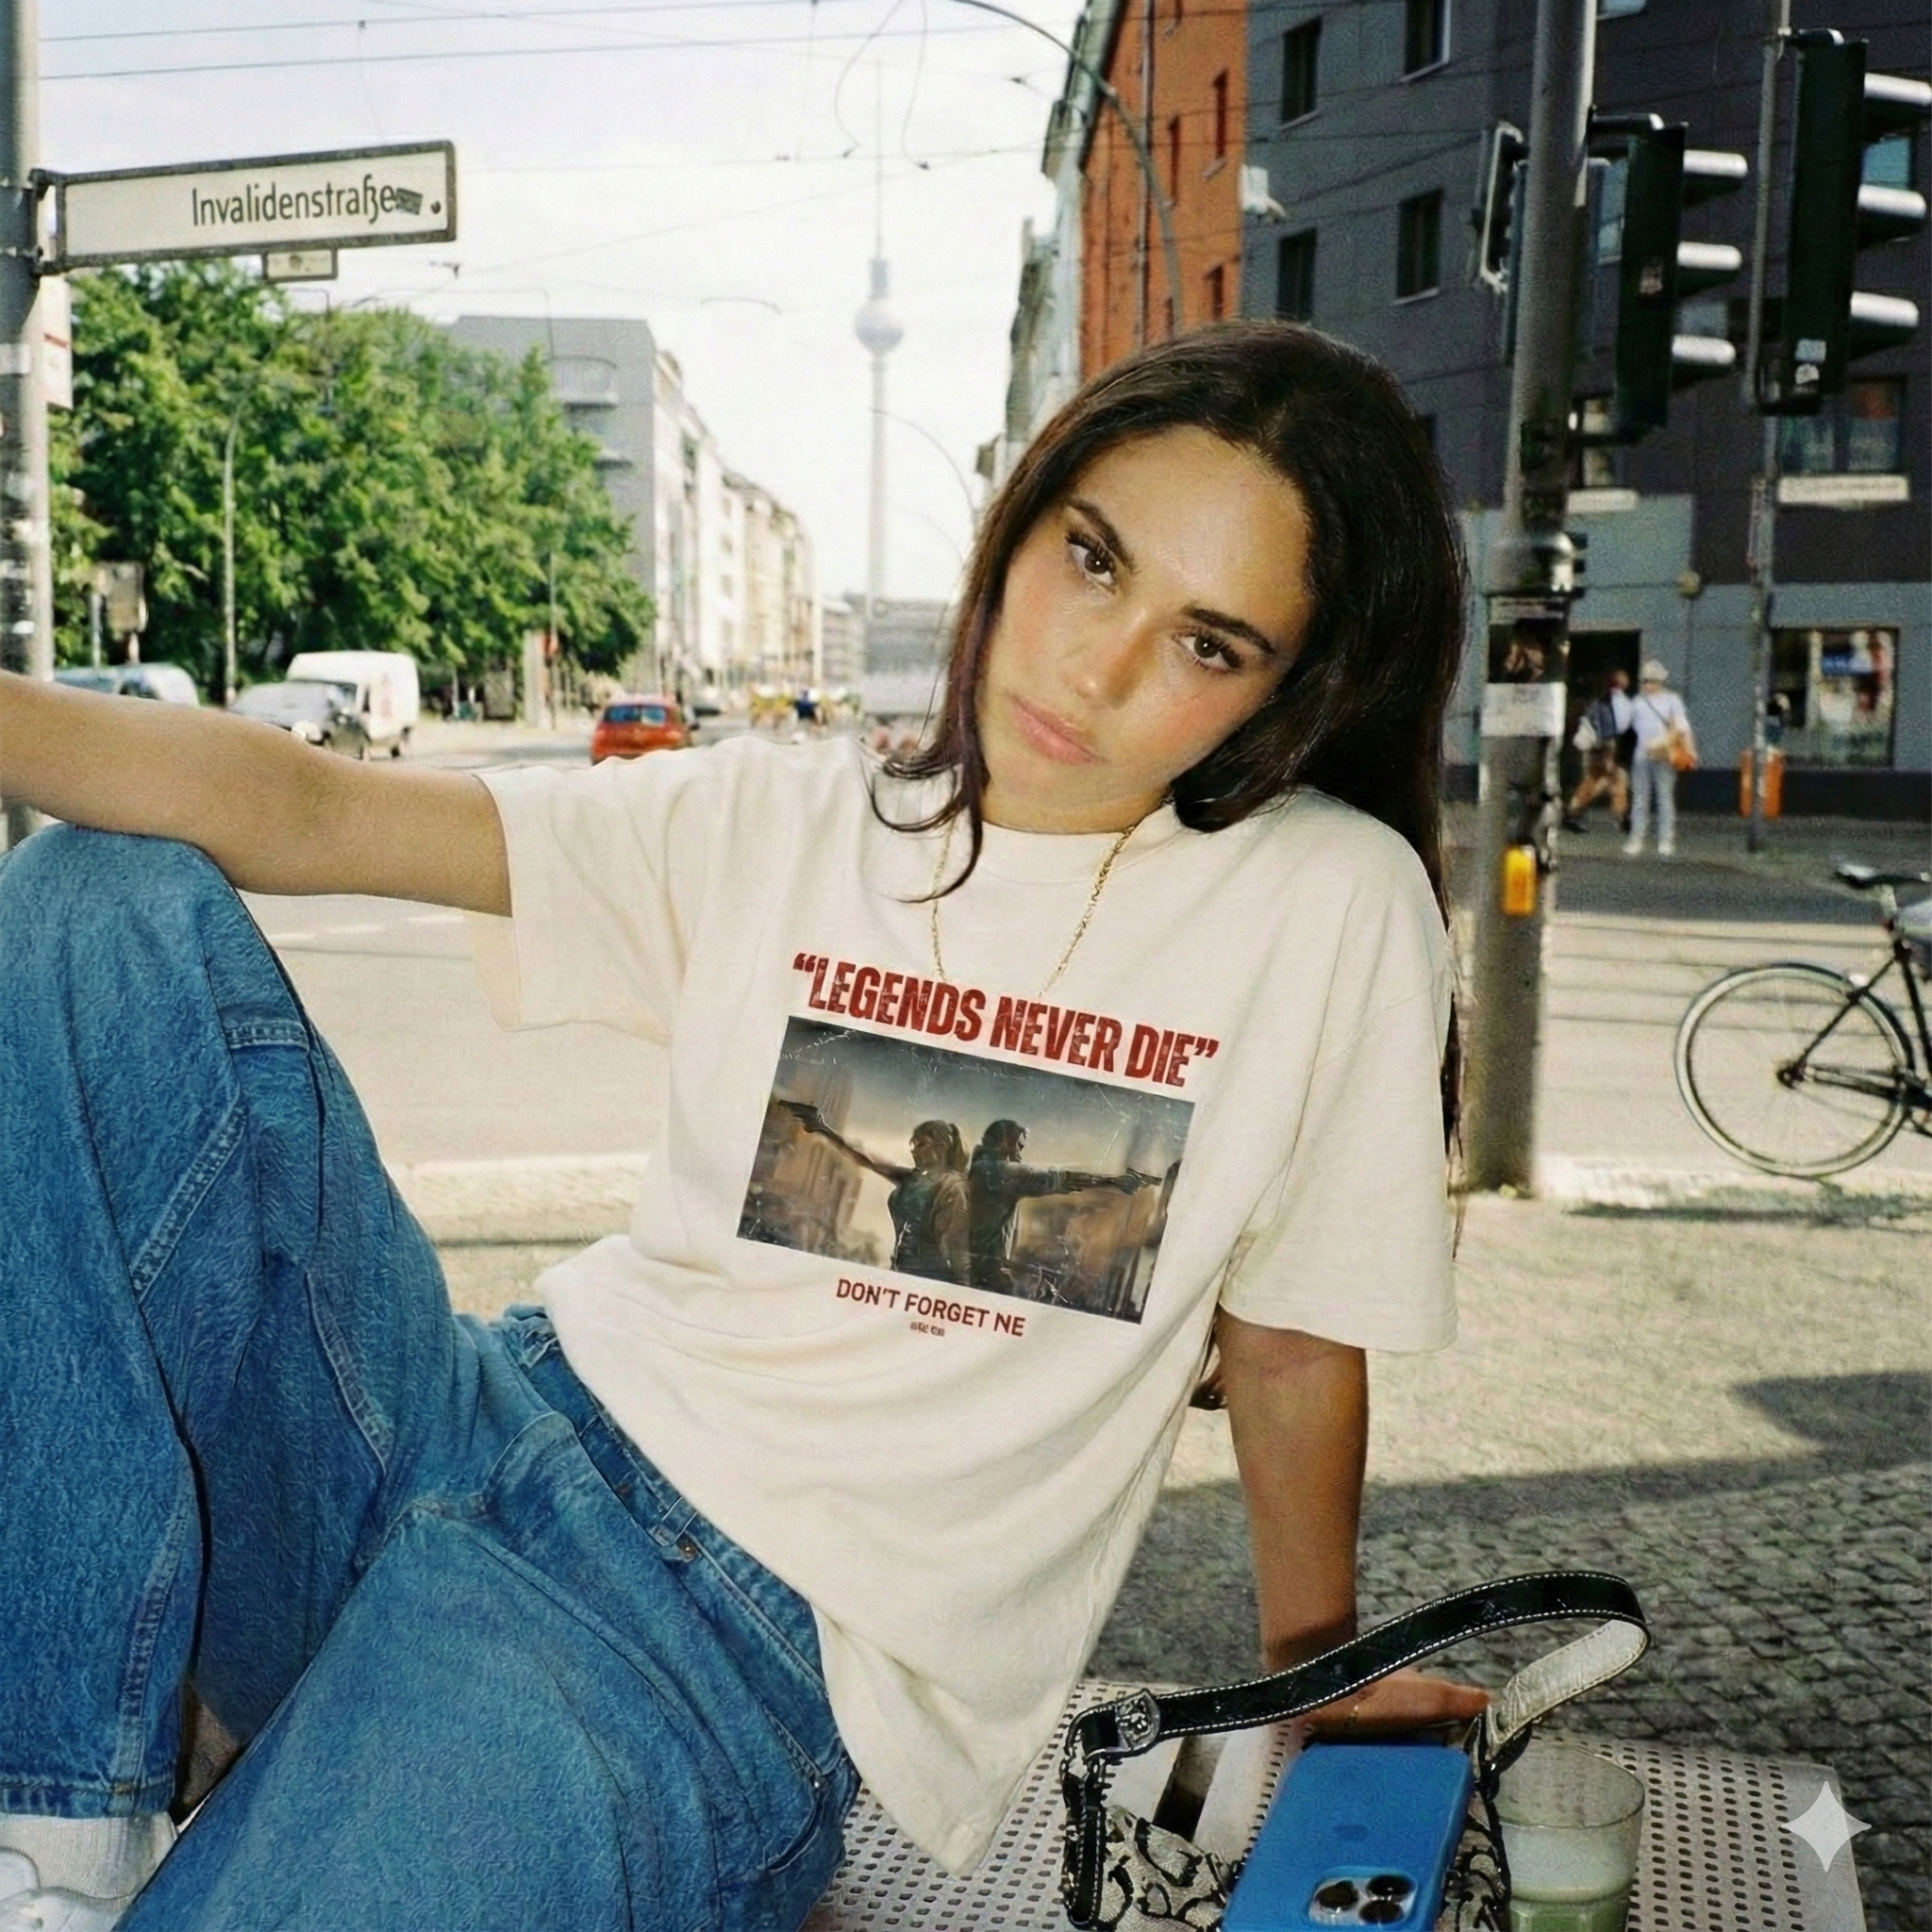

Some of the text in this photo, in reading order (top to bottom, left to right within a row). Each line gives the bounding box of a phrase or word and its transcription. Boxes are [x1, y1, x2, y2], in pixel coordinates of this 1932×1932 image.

[192, 174, 396, 226] Invalidenstraße
[990, 995, 1123, 1073] NEVER
[836, 1278, 901, 1308] DON'T
[904, 1292, 991, 1328] FORGET
